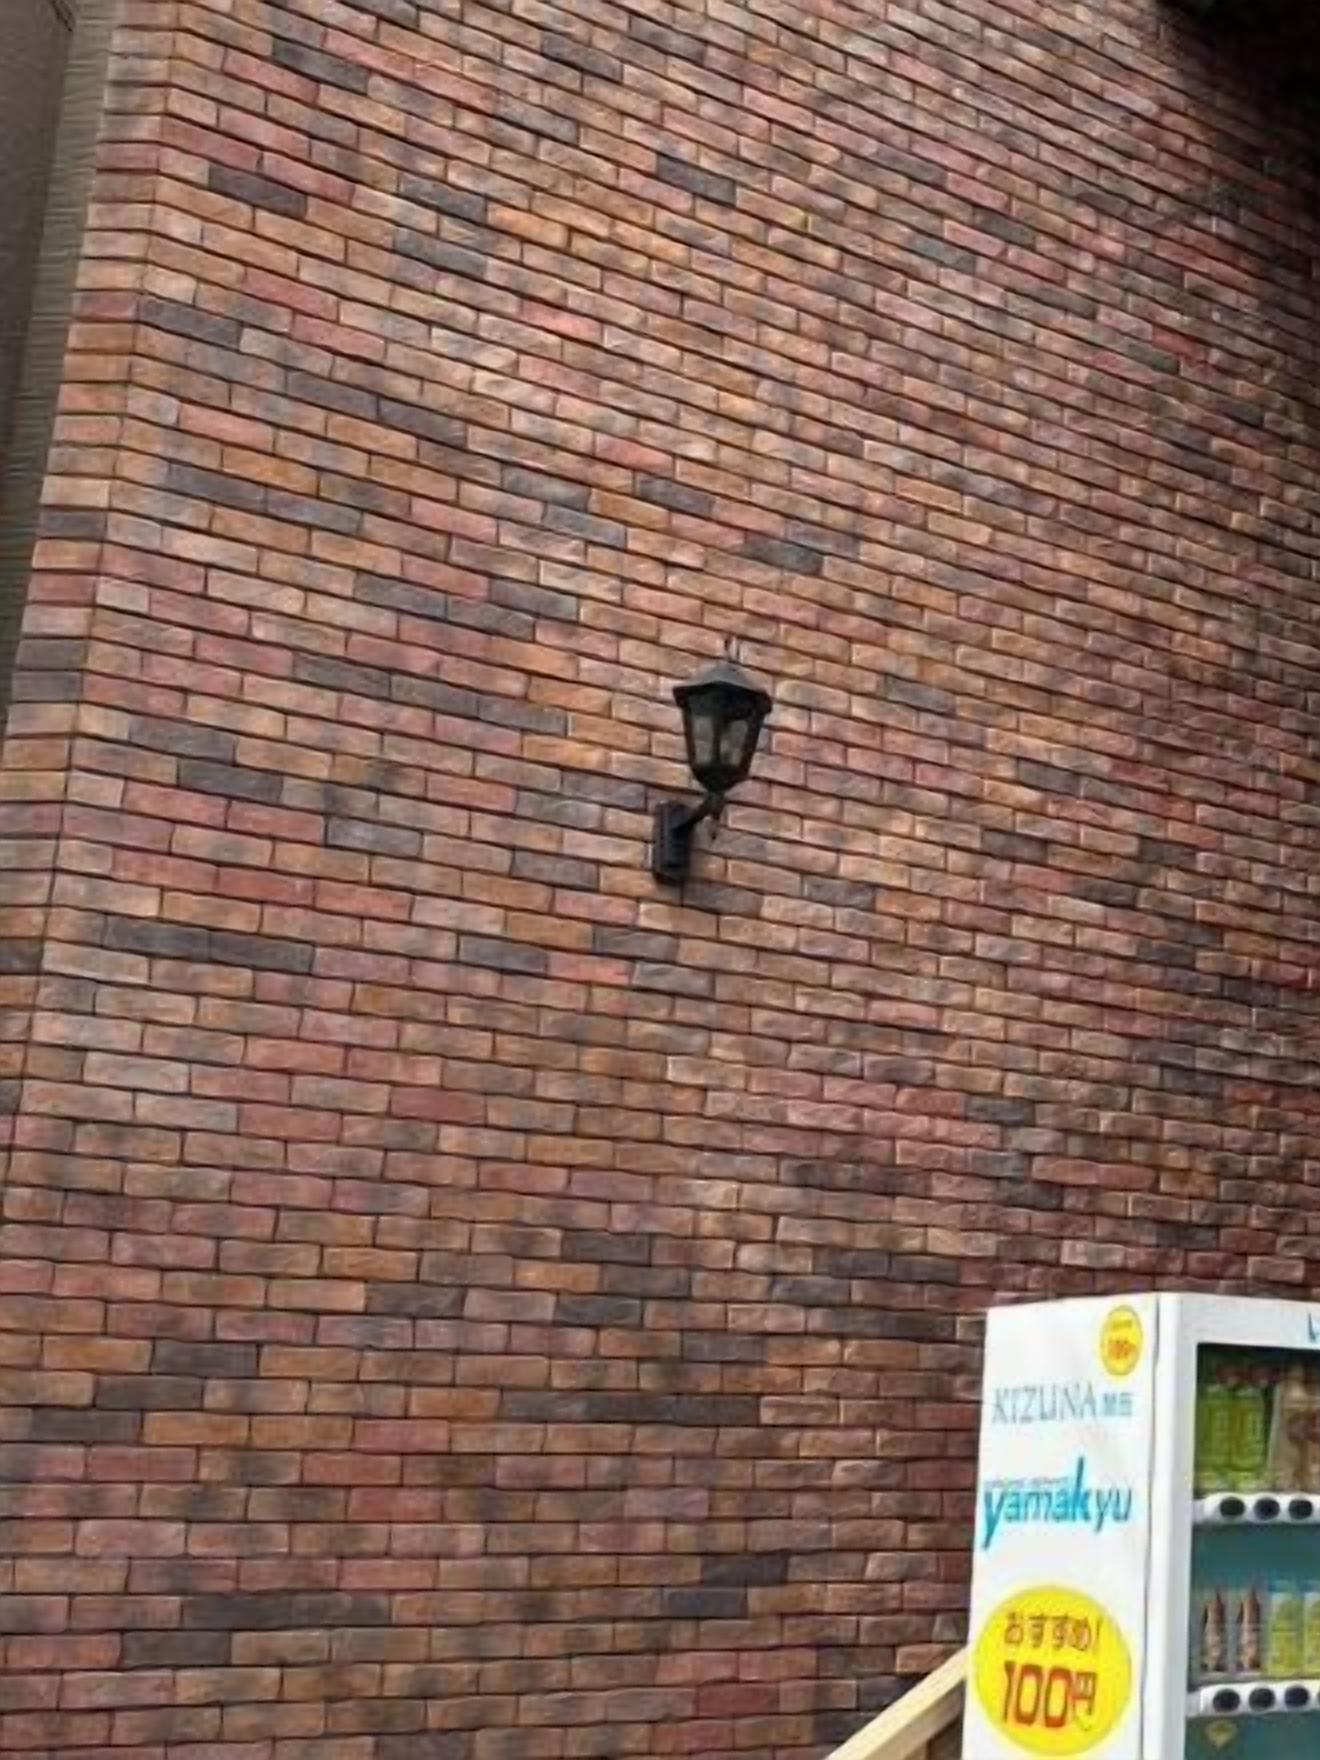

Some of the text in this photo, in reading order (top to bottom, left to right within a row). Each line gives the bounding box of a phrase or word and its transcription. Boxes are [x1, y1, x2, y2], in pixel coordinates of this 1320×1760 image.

[992, 1382, 1097, 1424] KIZUNA
[982, 1455, 1132, 1550] yamakyu
[1003, 1660, 1098, 1729] 100円
